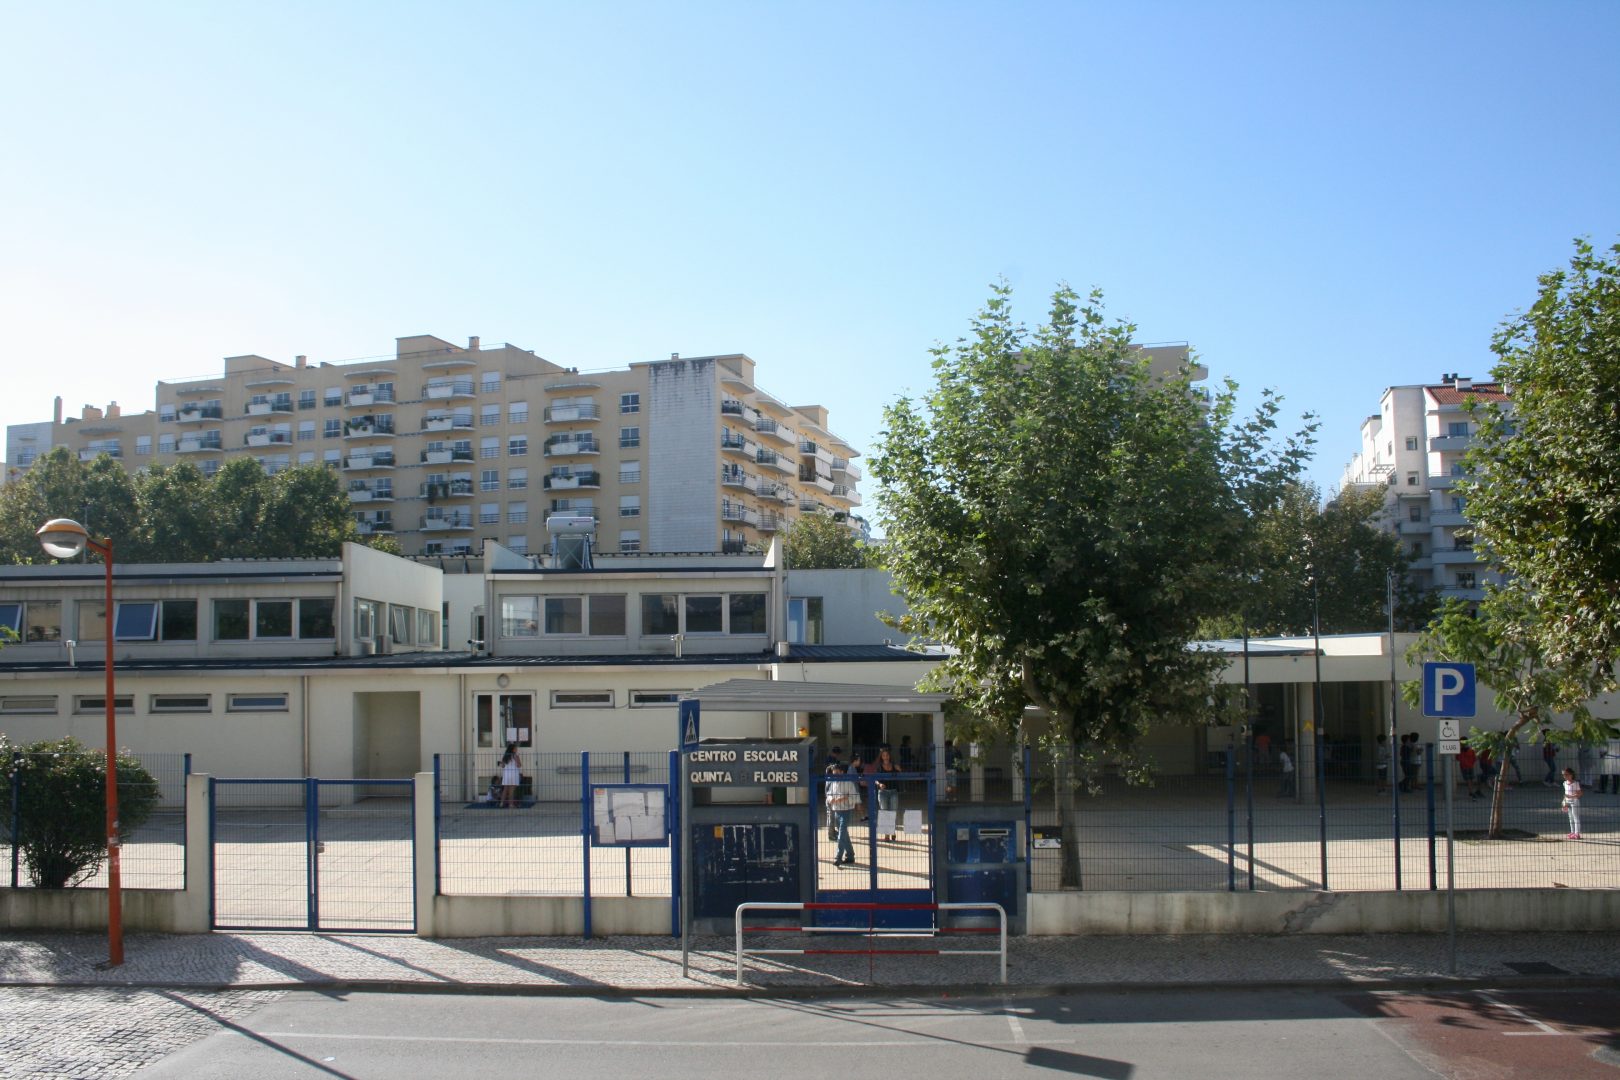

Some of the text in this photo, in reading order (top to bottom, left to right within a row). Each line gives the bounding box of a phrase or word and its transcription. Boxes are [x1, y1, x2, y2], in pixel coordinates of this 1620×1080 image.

[1435, 667, 1465, 712] P
[690, 751, 798, 761] CENTRO ESCOLAR
[690, 772, 733, 783] QUINTA
[753, 772, 798, 783] FLORES
